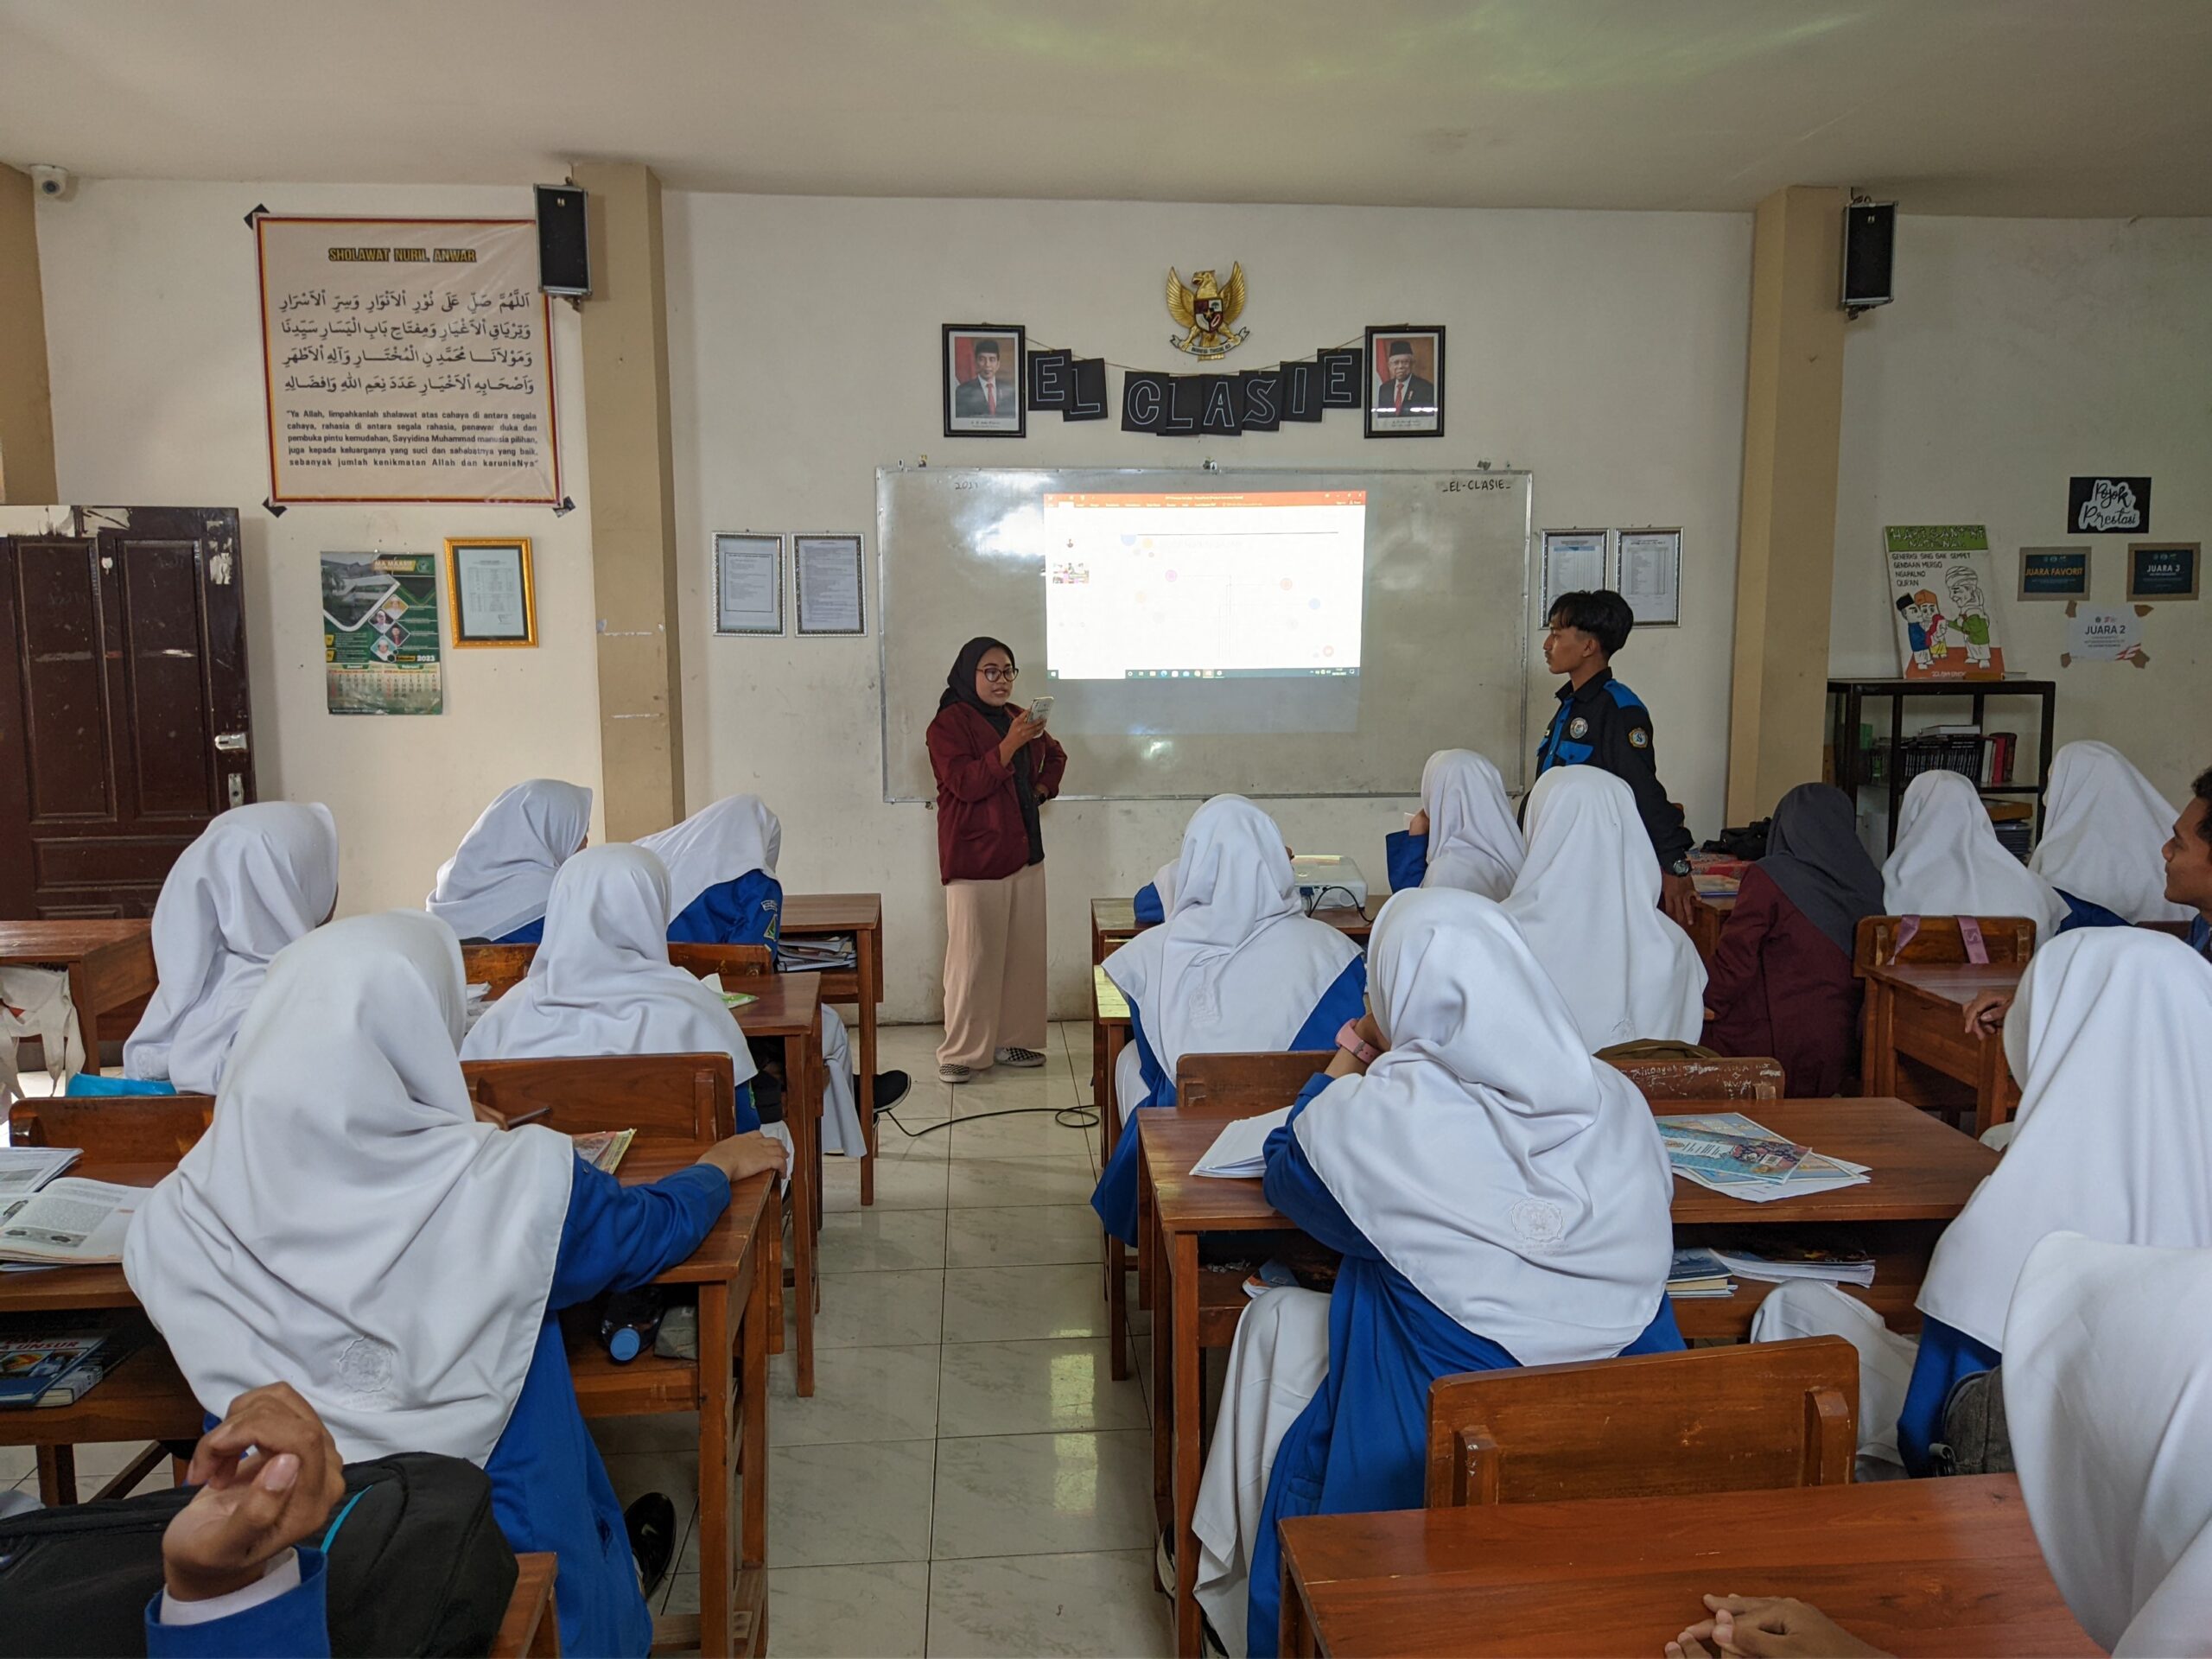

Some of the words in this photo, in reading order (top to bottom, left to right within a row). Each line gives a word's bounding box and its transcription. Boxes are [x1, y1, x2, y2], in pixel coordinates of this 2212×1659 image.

[328, 248, 391, 262] SHOLAWAT
[393, 248, 430, 262] NURIL
[432, 248, 477, 263] ANWAR
[1036, 356, 1101, 415] EL
[1128, 355, 1353, 429] CLASIE
[328, 410, 379, 419] limpahkanlah
[442, 411, 469, 421] cahaya
[512, 412, 537, 421] segala
[397, 423, 421, 431] segala
[288, 434, 322, 442] pembuka
[345, 434, 391, 442] kemudahan,
[392, 435, 429, 443] Sayyidina
[289, 446, 304, 454] juga
[308, 446, 336, 454] kepada
[340, 446, 386, 455] keluarganya
[449, 447, 493, 455] sahabatnya
[498, 448, 516, 456] yang
[289, 458, 332, 467] sebanyak
[338, 458, 368, 467] jumlah
[2095, 483, 2132, 509] Pojok
[2083, 505, 2136, 528] Prestasi
[2025, 567, 2049, 576] JUARA
[2050, 567, 2083, 576] FAVORIT
[2146, 564, 2173, 573] JUARA
[2084, 626, 2117, 634] JUARA
[2120, 625, 2126, 634] 2
